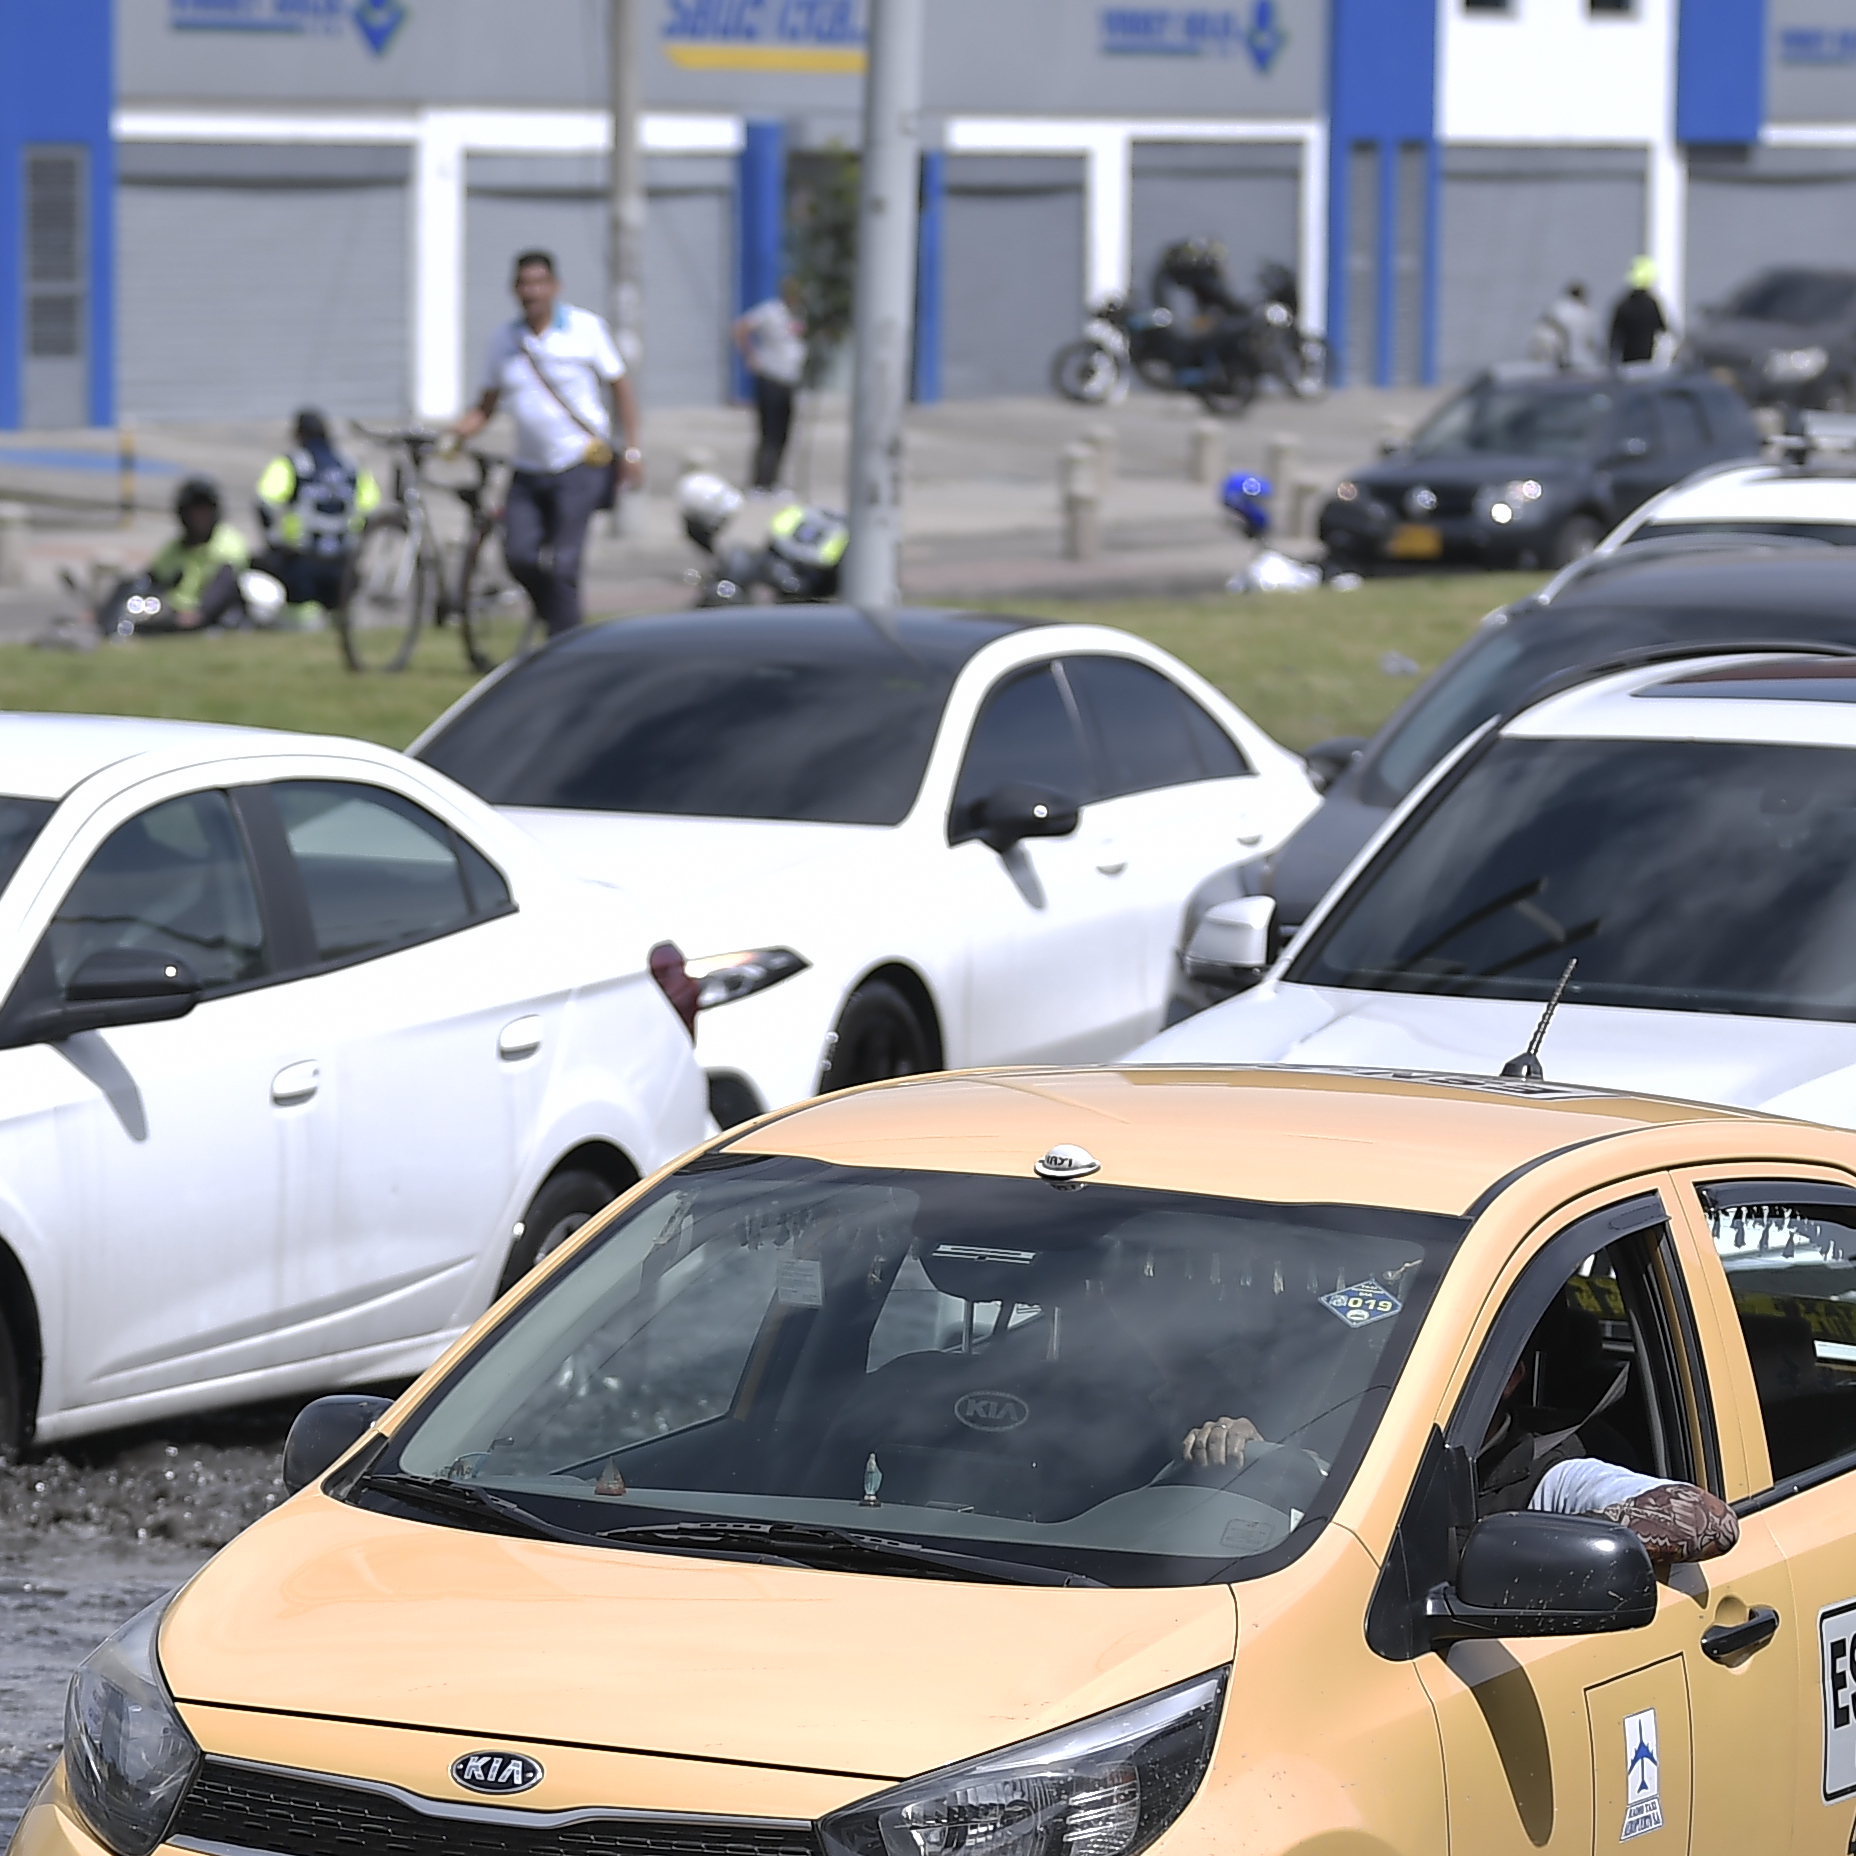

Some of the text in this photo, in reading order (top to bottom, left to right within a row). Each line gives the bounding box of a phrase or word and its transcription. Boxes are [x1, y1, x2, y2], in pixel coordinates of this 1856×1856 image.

[1348, 1297, 1393, 1312] 019
[966, 1400, 1018, 1420] KIA
[463, 1756, 523, 1785] KIA
